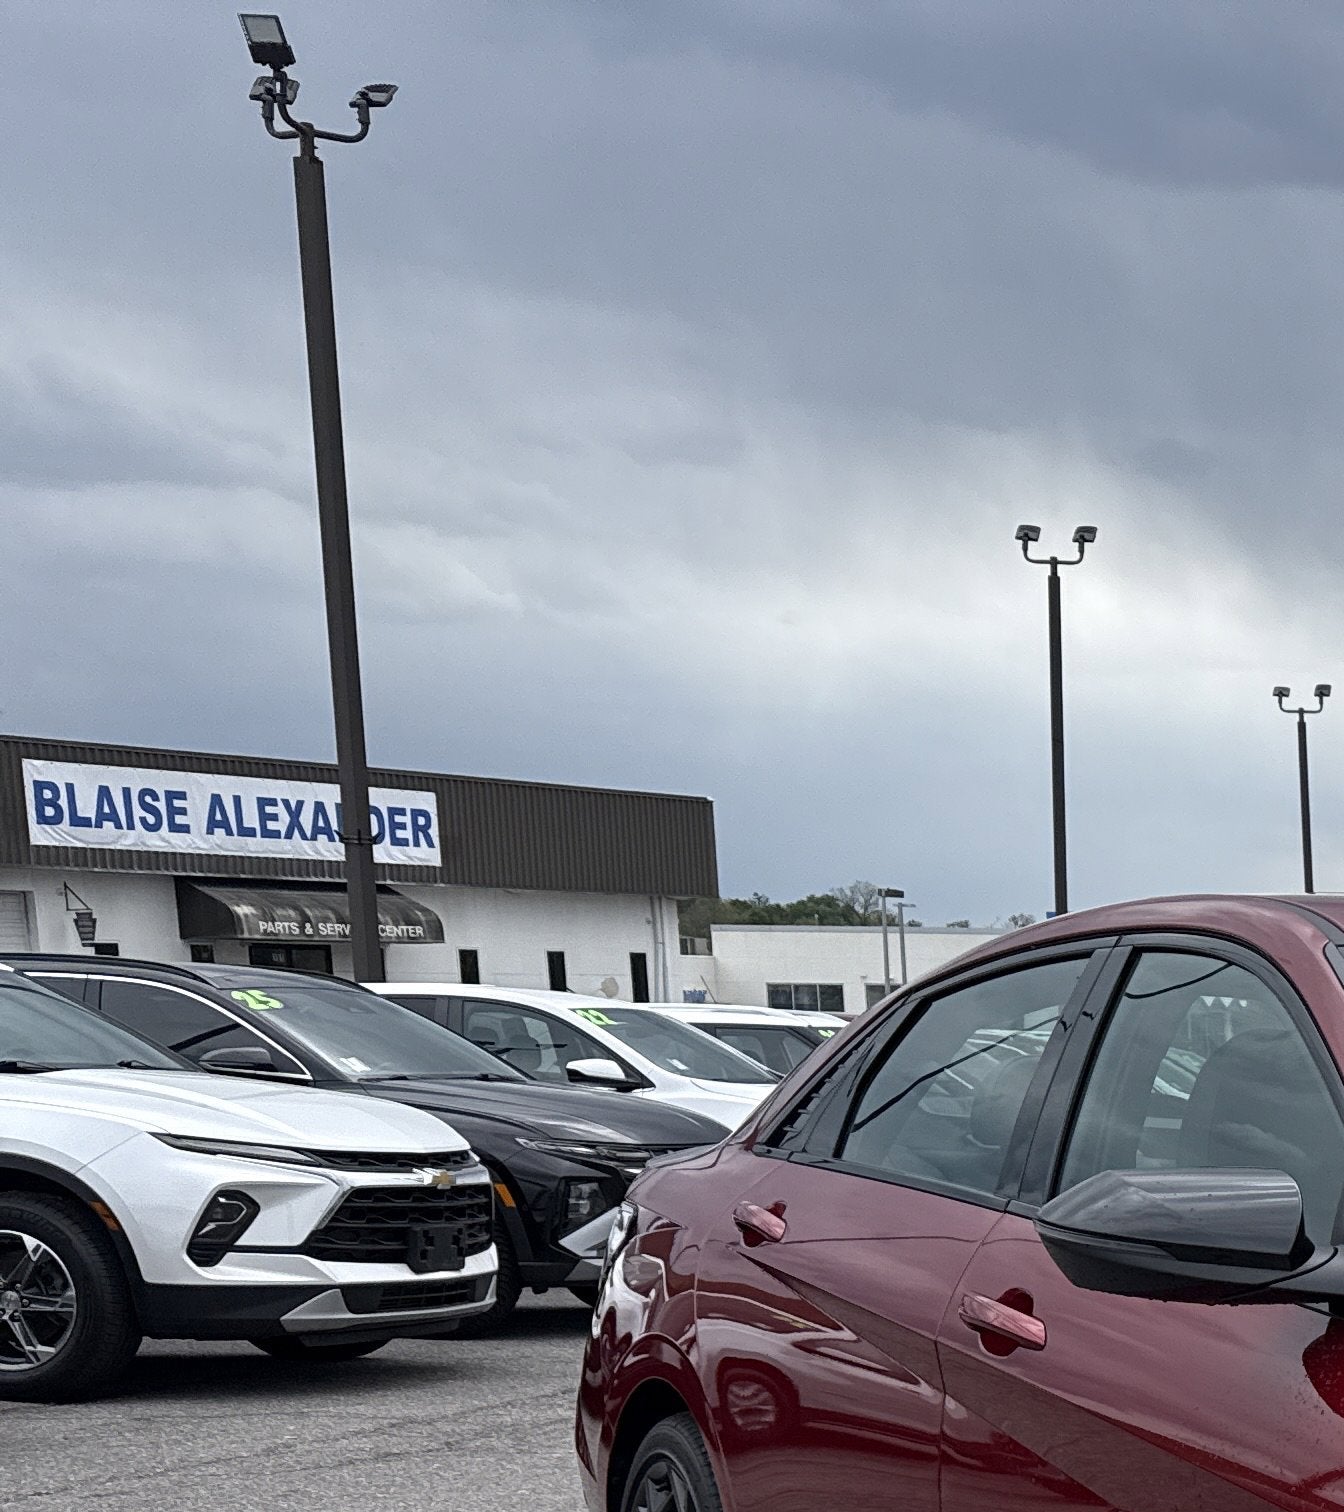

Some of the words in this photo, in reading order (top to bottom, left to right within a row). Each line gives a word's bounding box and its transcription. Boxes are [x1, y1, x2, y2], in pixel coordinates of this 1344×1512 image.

[33, 779, 191, 834] BLAISE
[259, 921, 300, 935] PARTS
[304, 923, 314, 935] &
[378, 924, 424, 938] CENTER
[230, 989, 284, 1010] 25
